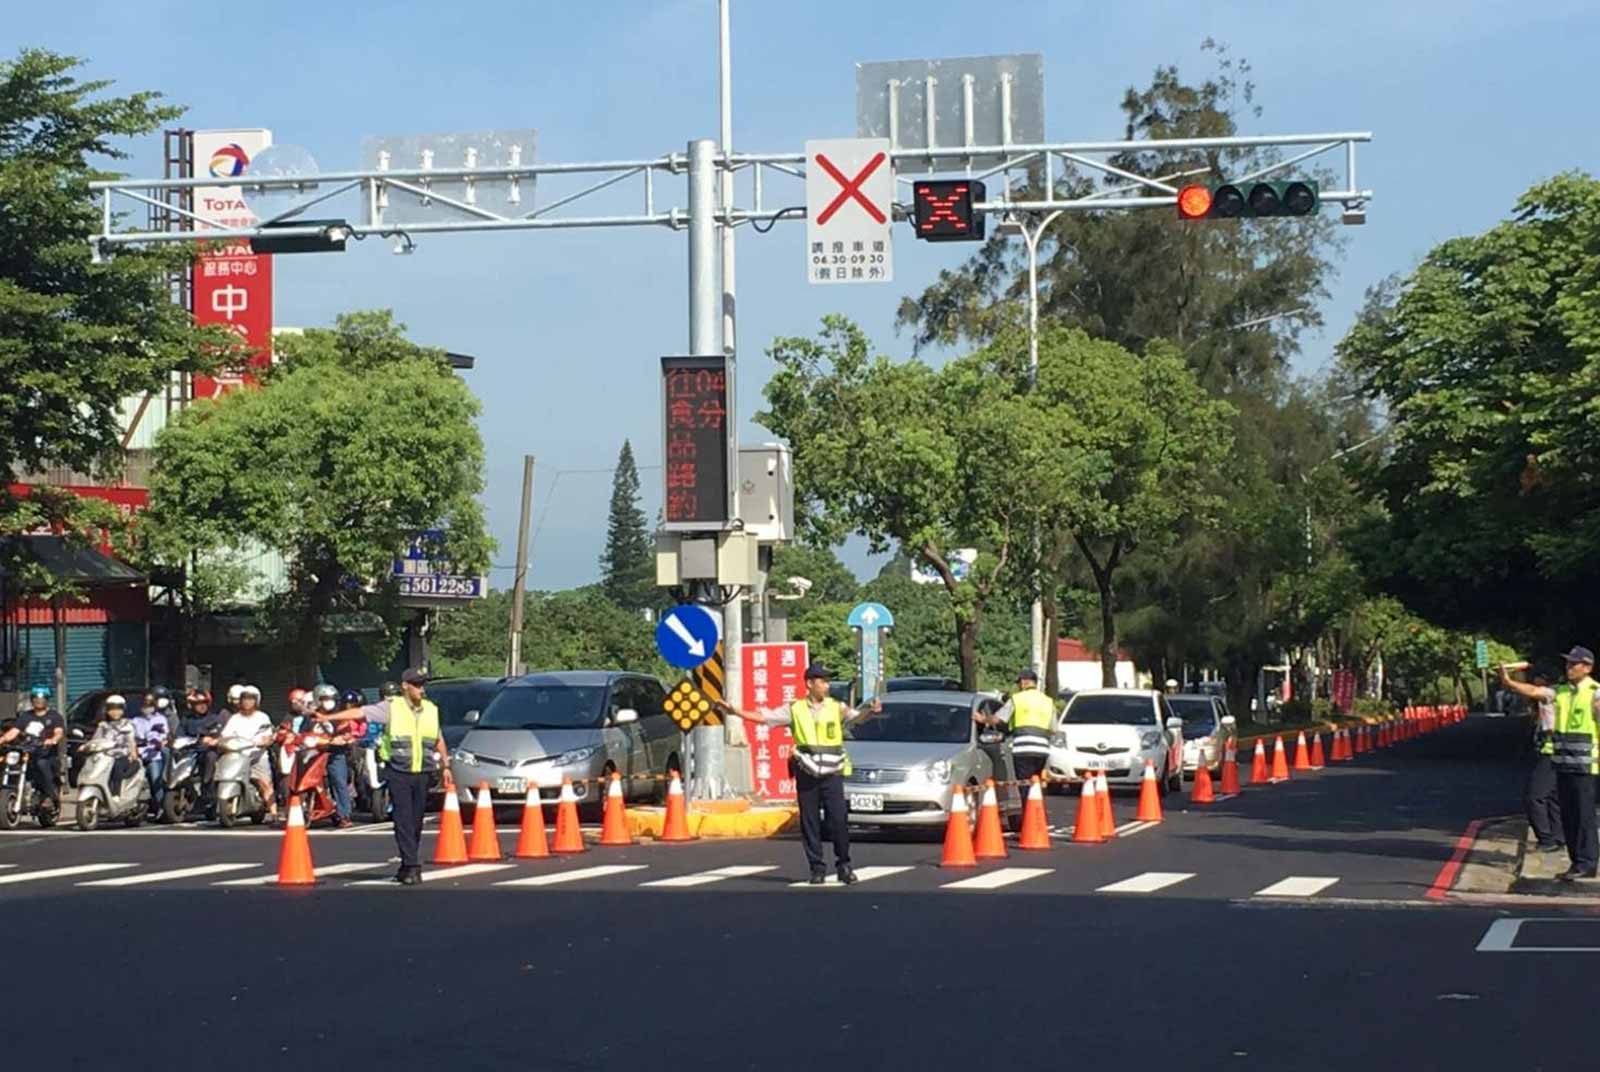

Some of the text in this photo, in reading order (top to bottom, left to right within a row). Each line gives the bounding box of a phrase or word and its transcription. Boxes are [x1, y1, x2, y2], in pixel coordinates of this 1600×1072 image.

[203, 197, 246, 211] TOTA
[203, 260, 258, 277] 服務中心
[411, 578, 474, 594] 5612285
[752, 649, 772, 796] 調撥車禁止進入
